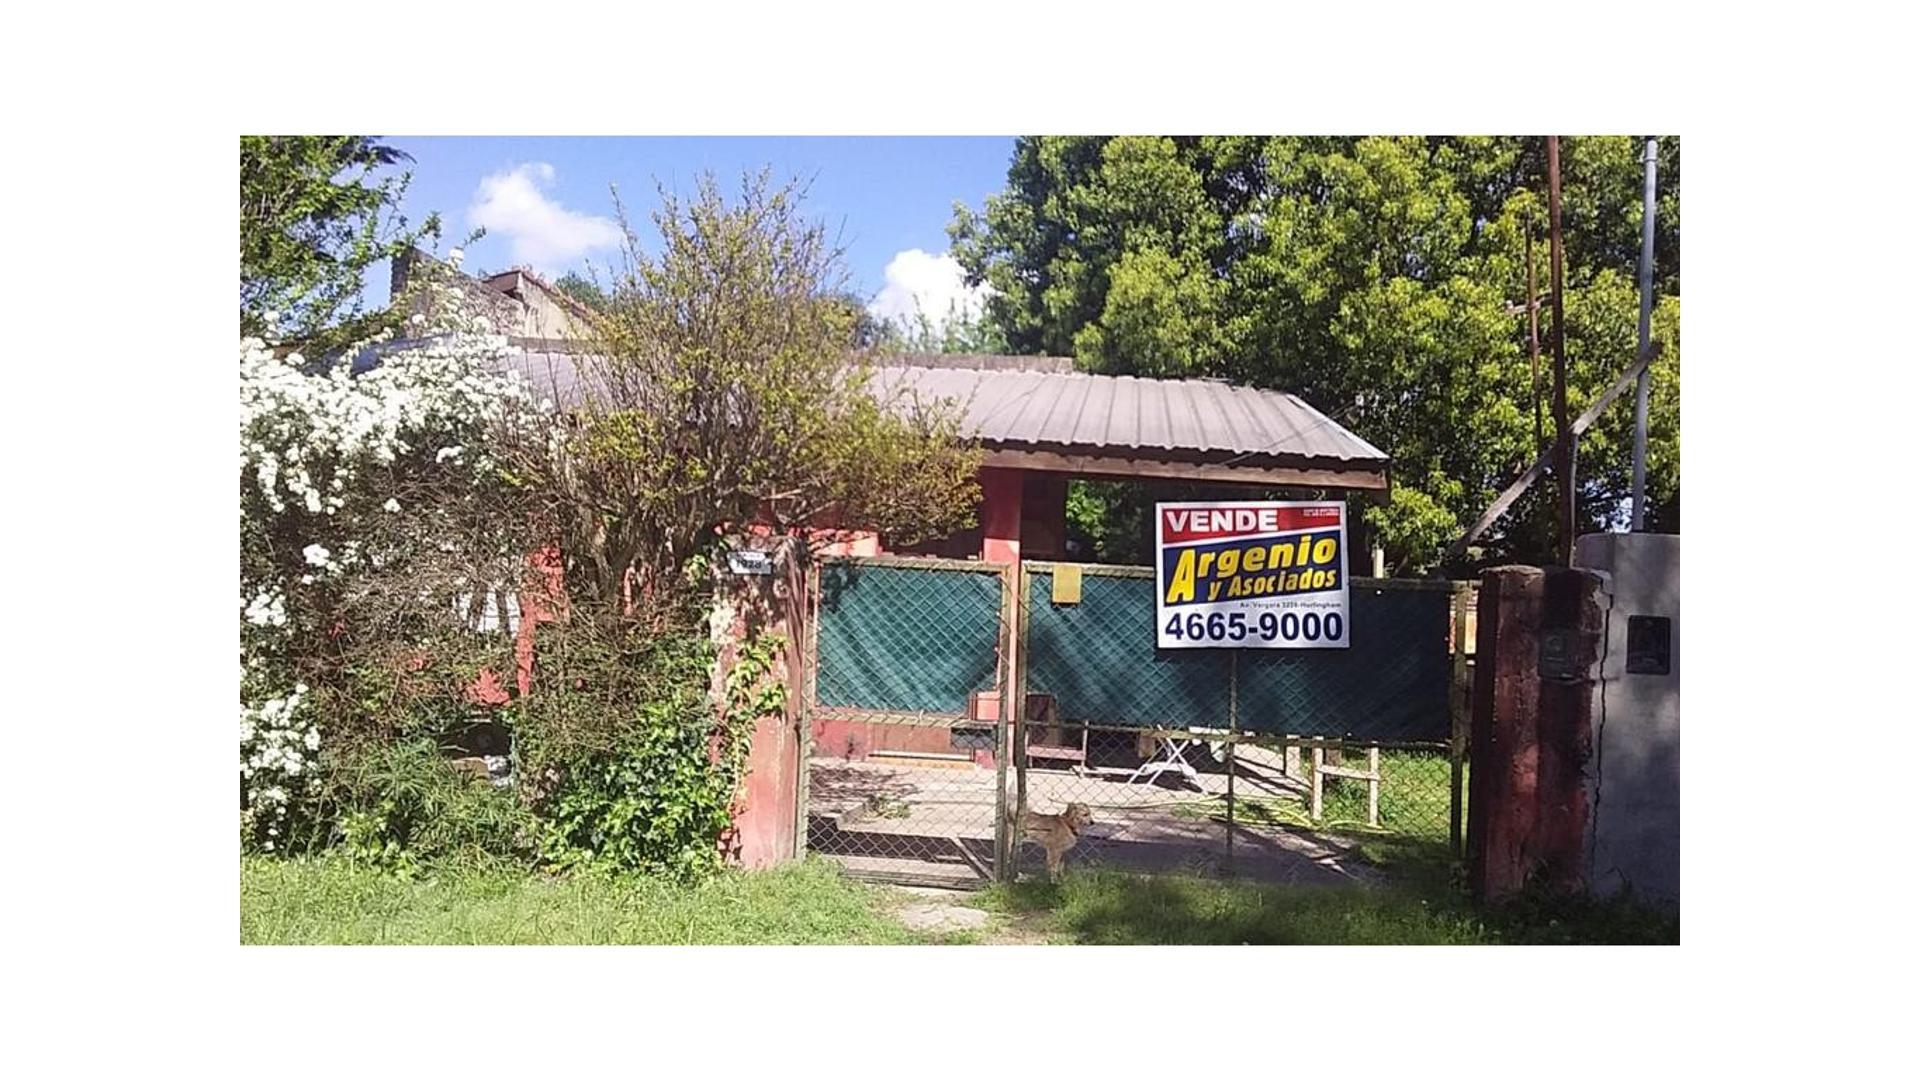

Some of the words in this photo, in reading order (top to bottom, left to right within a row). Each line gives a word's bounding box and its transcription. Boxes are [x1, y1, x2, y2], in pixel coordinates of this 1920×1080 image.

[1166, 509, 1279, 532] VENDE
[1165, 535, 1337, 604] Argenio
[1207, 580, 1221, 601] y
[1228, 568, 1337, 597] Asociados
[1165, 612, 1343, 642] 4665-9000
